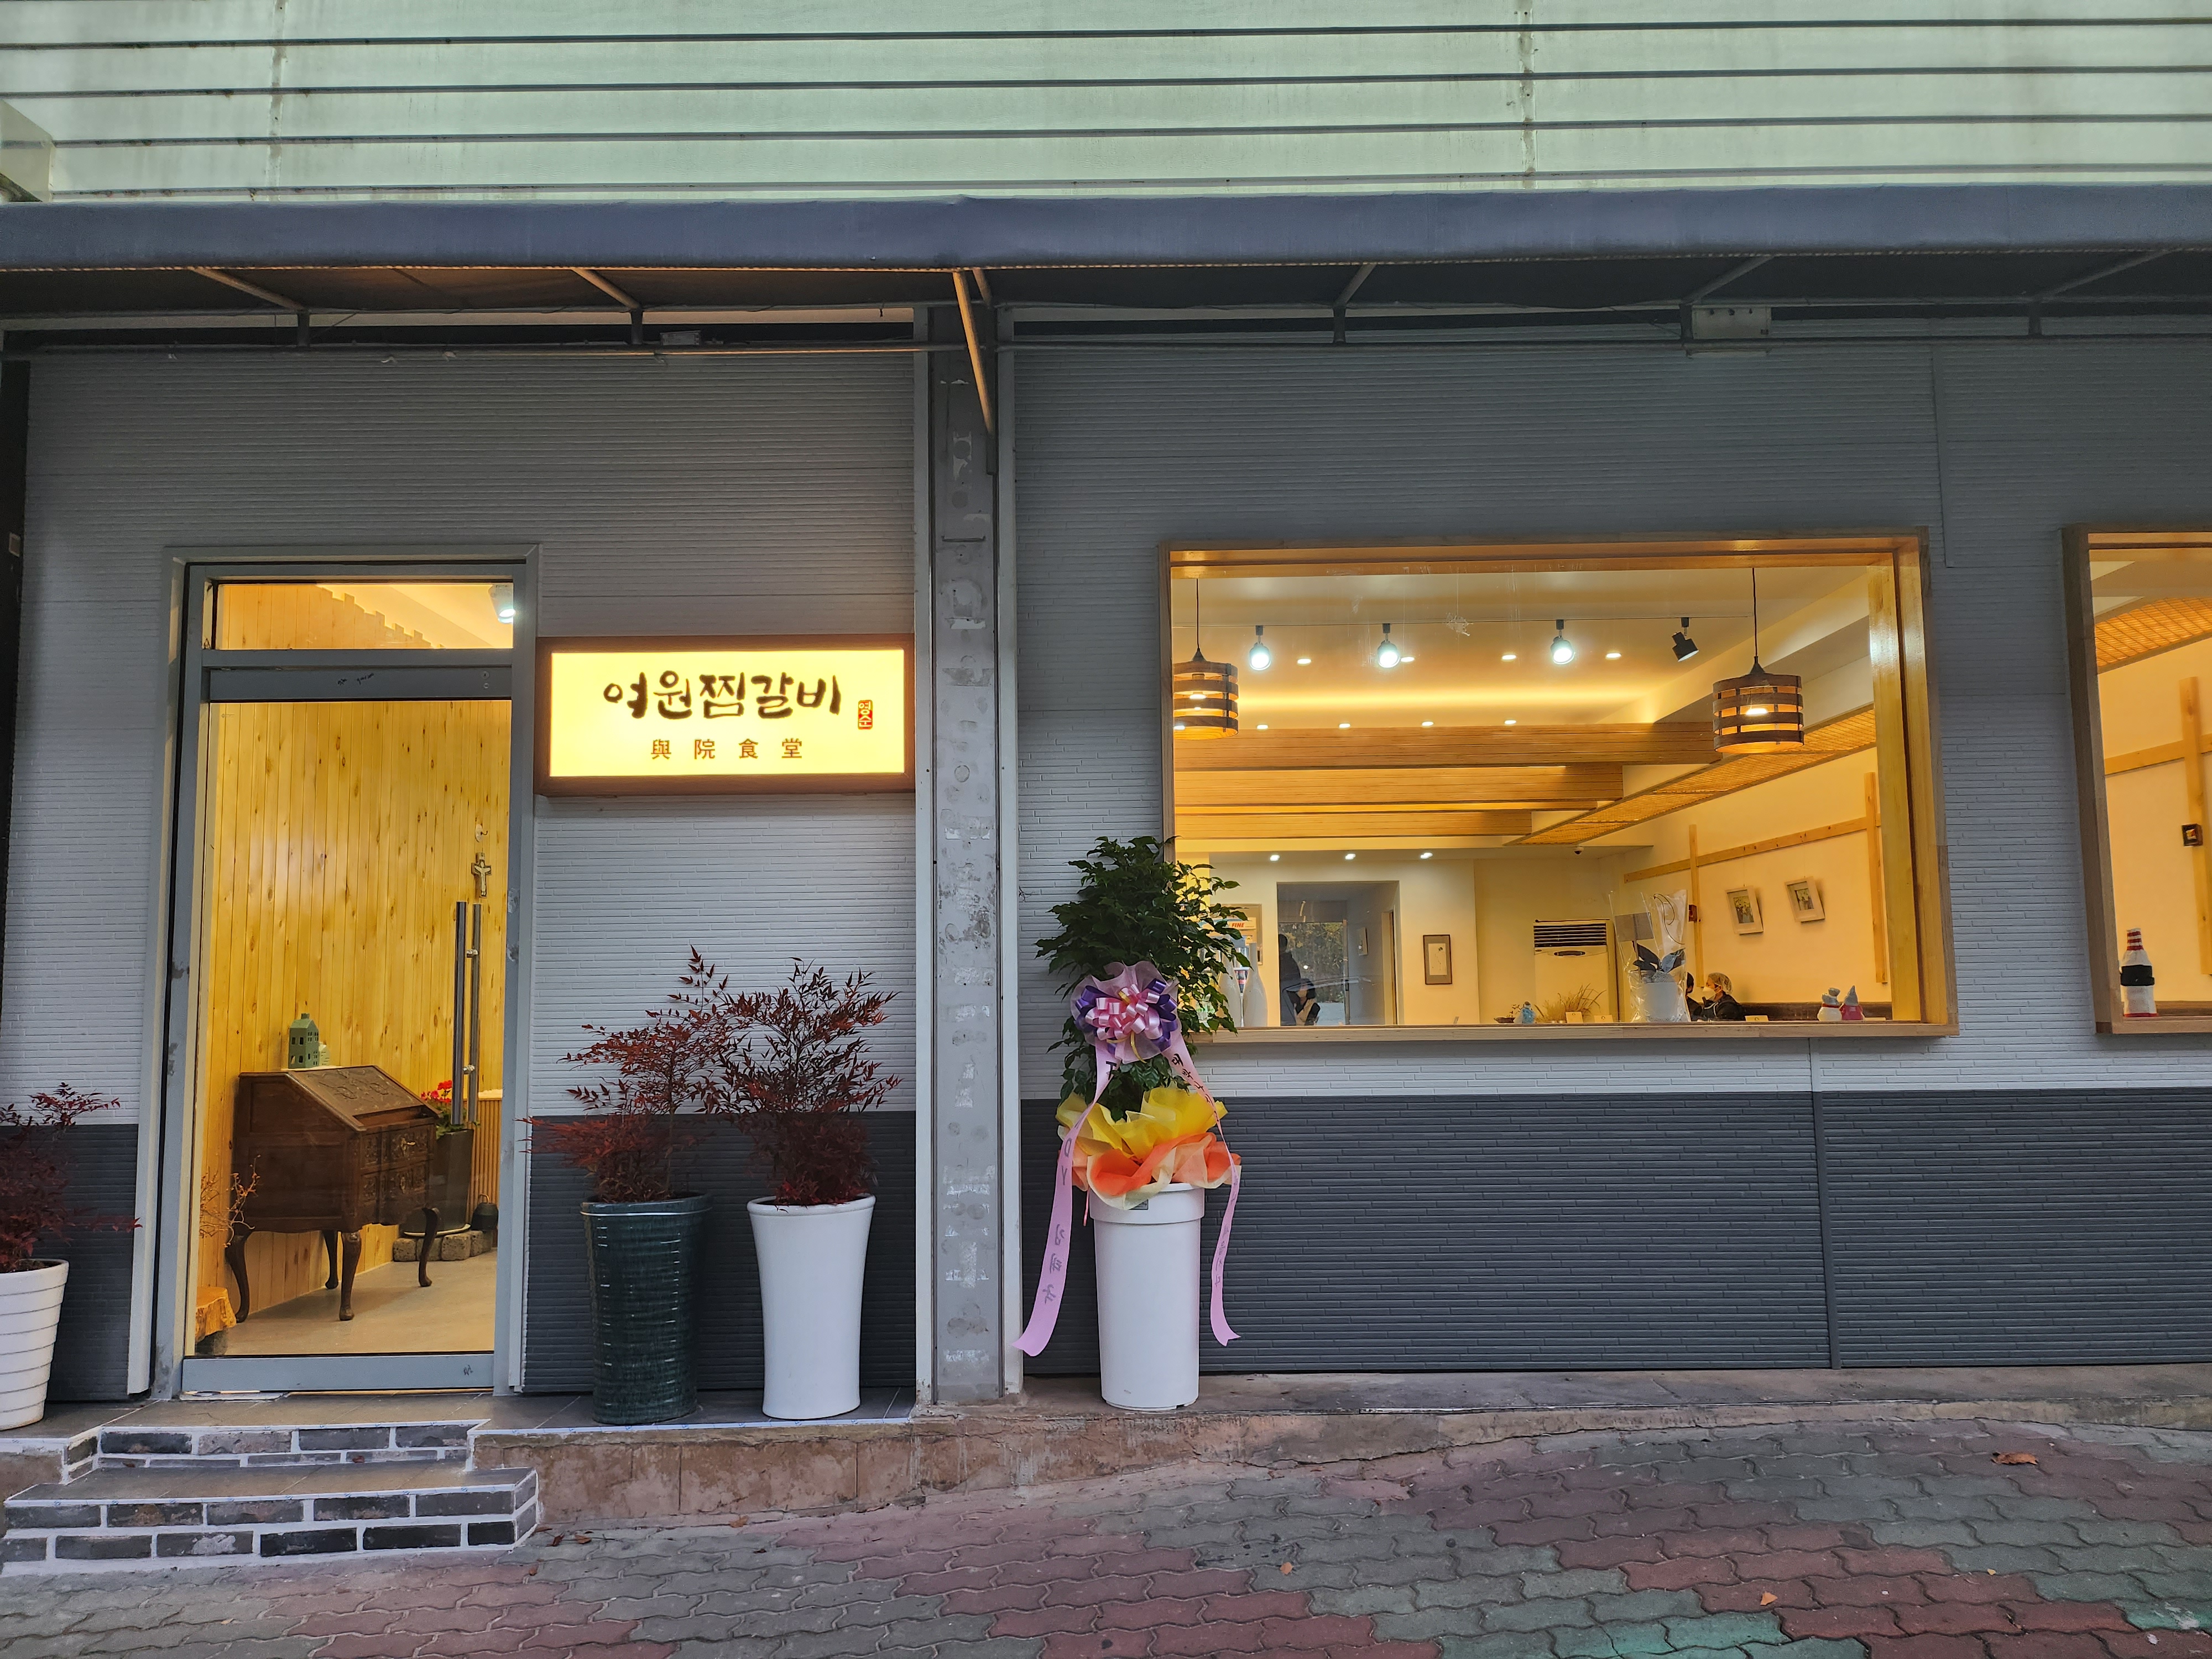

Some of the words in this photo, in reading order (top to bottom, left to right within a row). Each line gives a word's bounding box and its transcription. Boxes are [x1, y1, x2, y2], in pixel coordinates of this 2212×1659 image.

[603, 670, 841, 719] 여원찜갈비
[858, 701, 873, 727] 영준
[650, 738, 802, 759] 與院食堂
[1171, 1053, 1219, 1122] 대박나시
